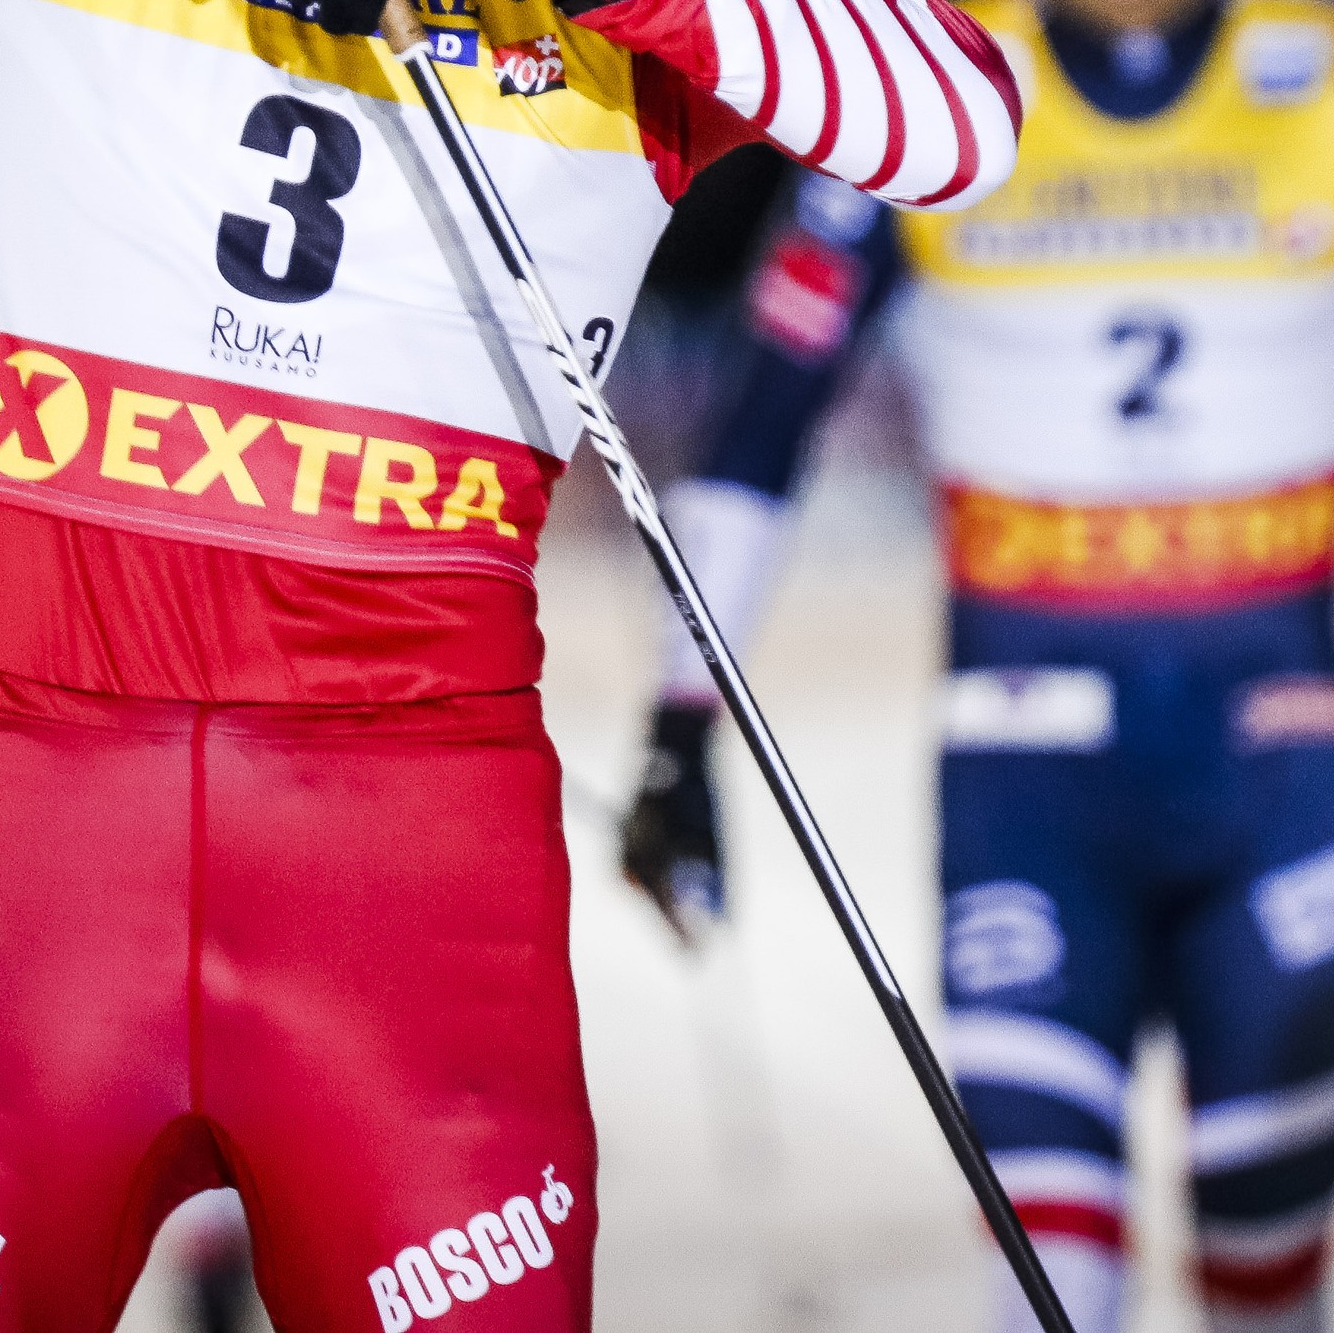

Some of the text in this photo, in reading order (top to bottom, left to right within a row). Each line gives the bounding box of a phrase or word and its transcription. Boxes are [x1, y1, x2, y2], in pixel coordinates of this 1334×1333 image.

[215, 94, 362, 304] 3
[210, 305, 323, 364] RUKA!
[1102, 309, 1189, 424] 2
[99, 387, 519, 539] EXTRA
[367, 1194, 556, 1333] BOSCO
